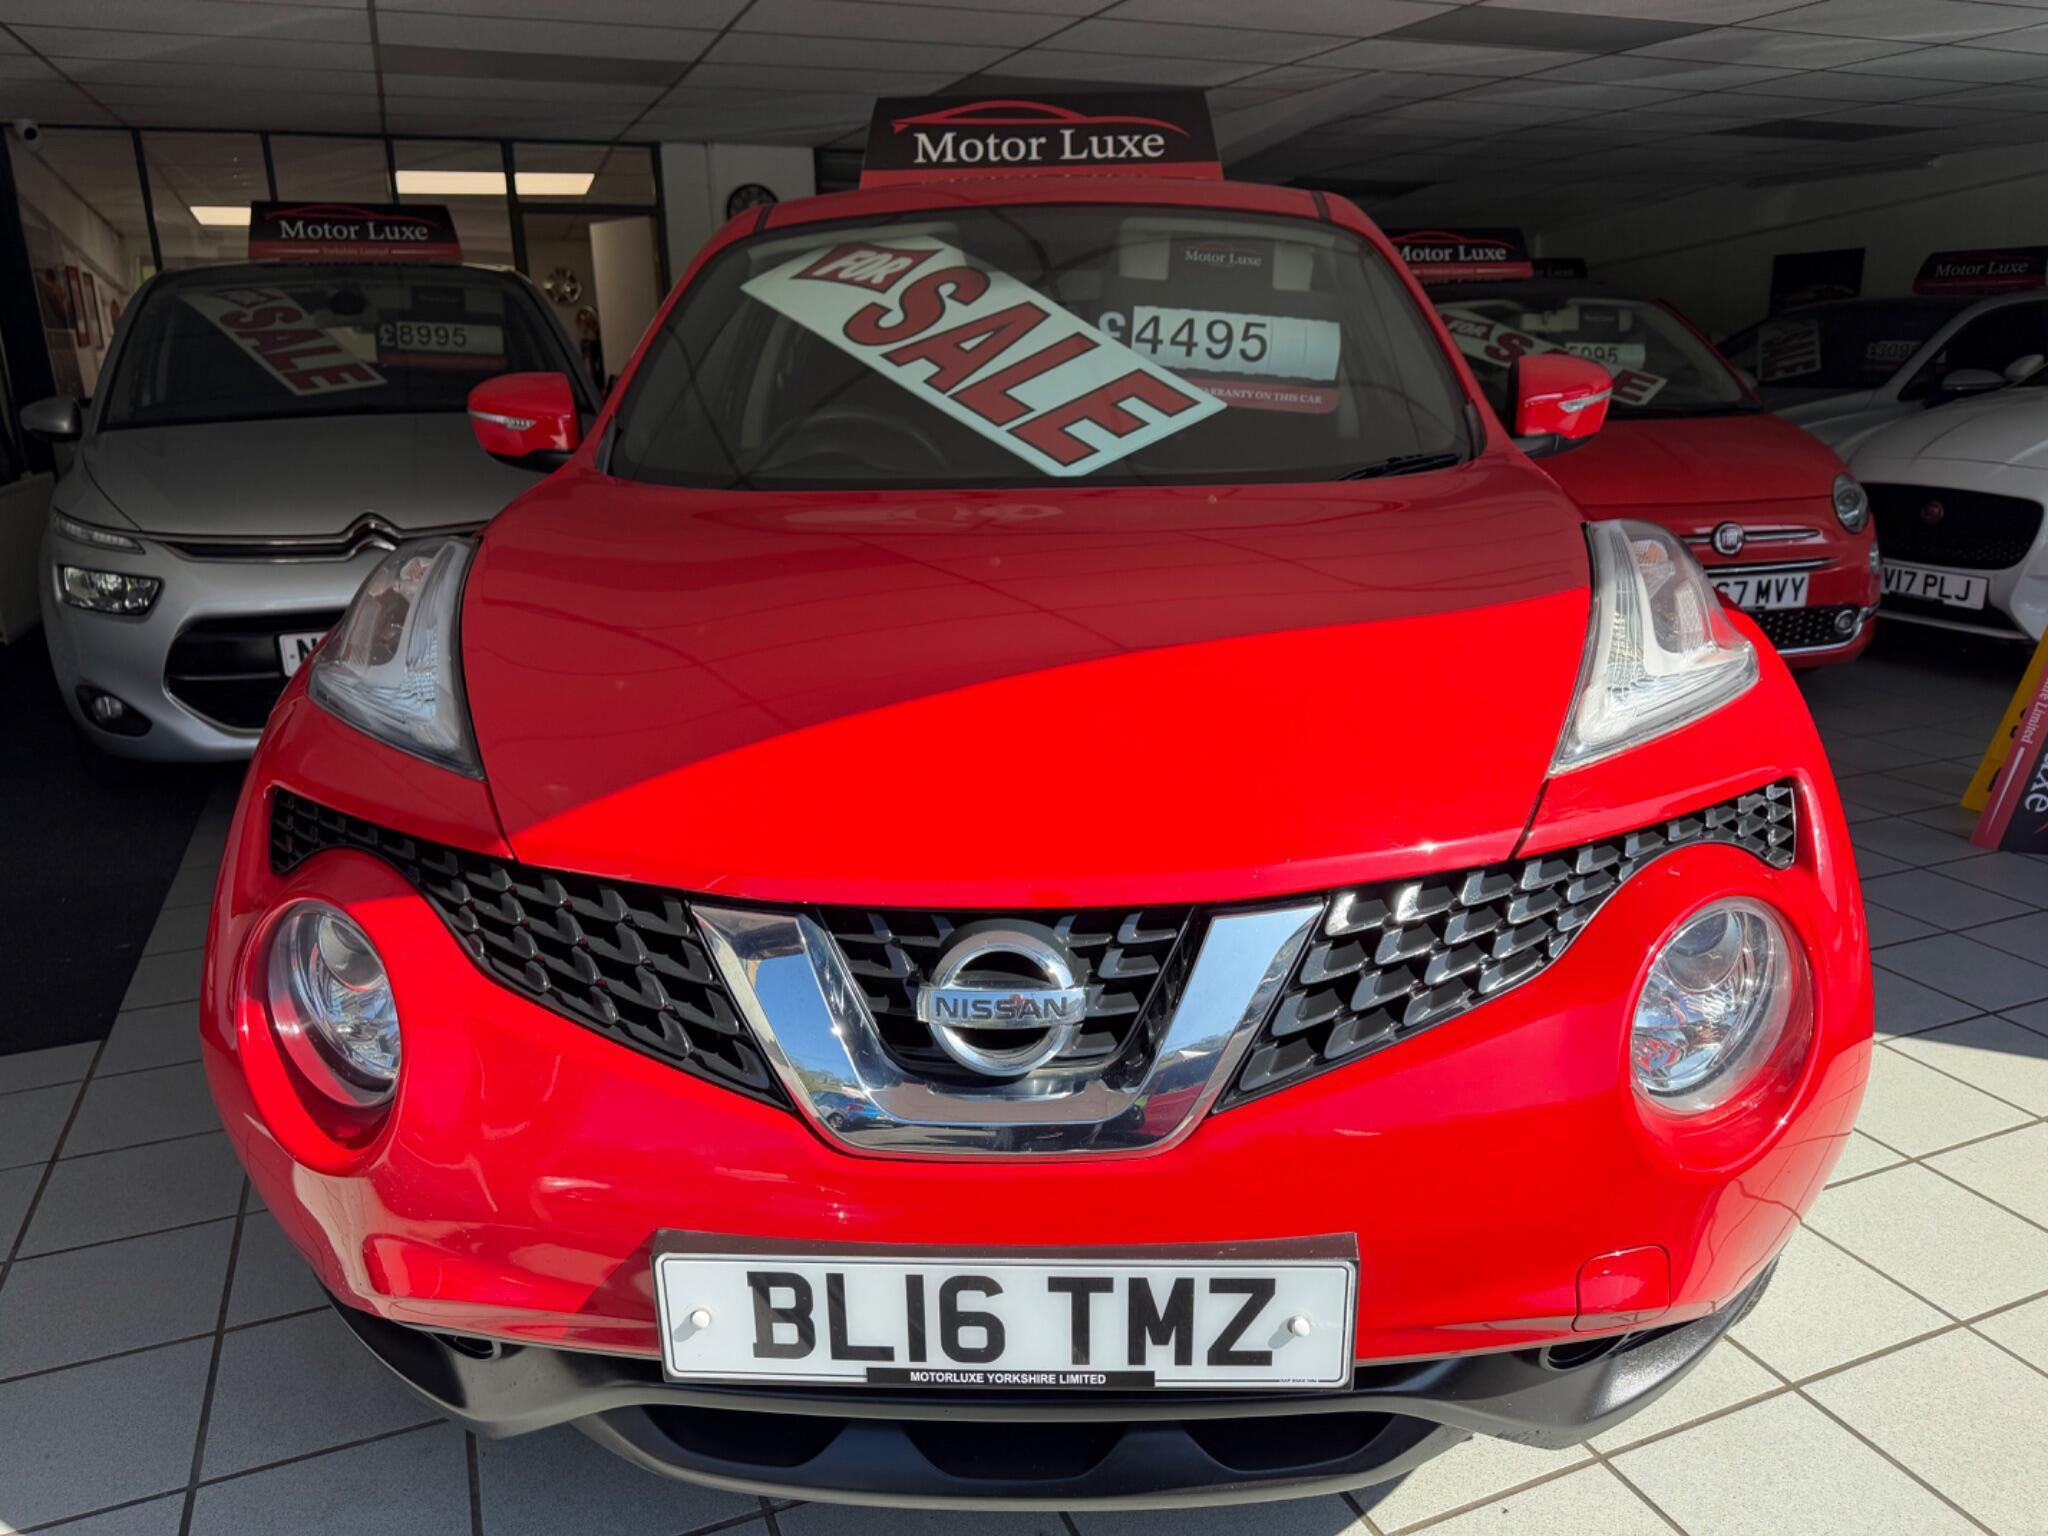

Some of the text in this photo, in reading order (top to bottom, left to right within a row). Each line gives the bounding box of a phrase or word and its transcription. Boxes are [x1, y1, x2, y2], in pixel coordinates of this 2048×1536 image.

[913, 128, 1166, 164] Motor Luxe
[279, 219, 429, 241] Motor Luxe
[1185, 249, 1263, 267] Motor Luxe
[1457, 244, 1507, 261] Luxe
[816, 250, 904, 285] FOR
[1934, 260, 2030, 278] Motor Luxe
[219, 305, 377, 391] SALE
[378, 323, 468, 347] £8995
[843, 265, 1201, 467] SALE
[1755, 577, 1806, 605] MVY
[1922, 573, 1972, 602] PLJ
[935, 996, 1068, 1020] NISSAN
[746, 1270, 1277, 1366] BL16 TMZ
[910, 1371, 1107, 1385] MOTORLUXE YORKSHIRE LIMITED
